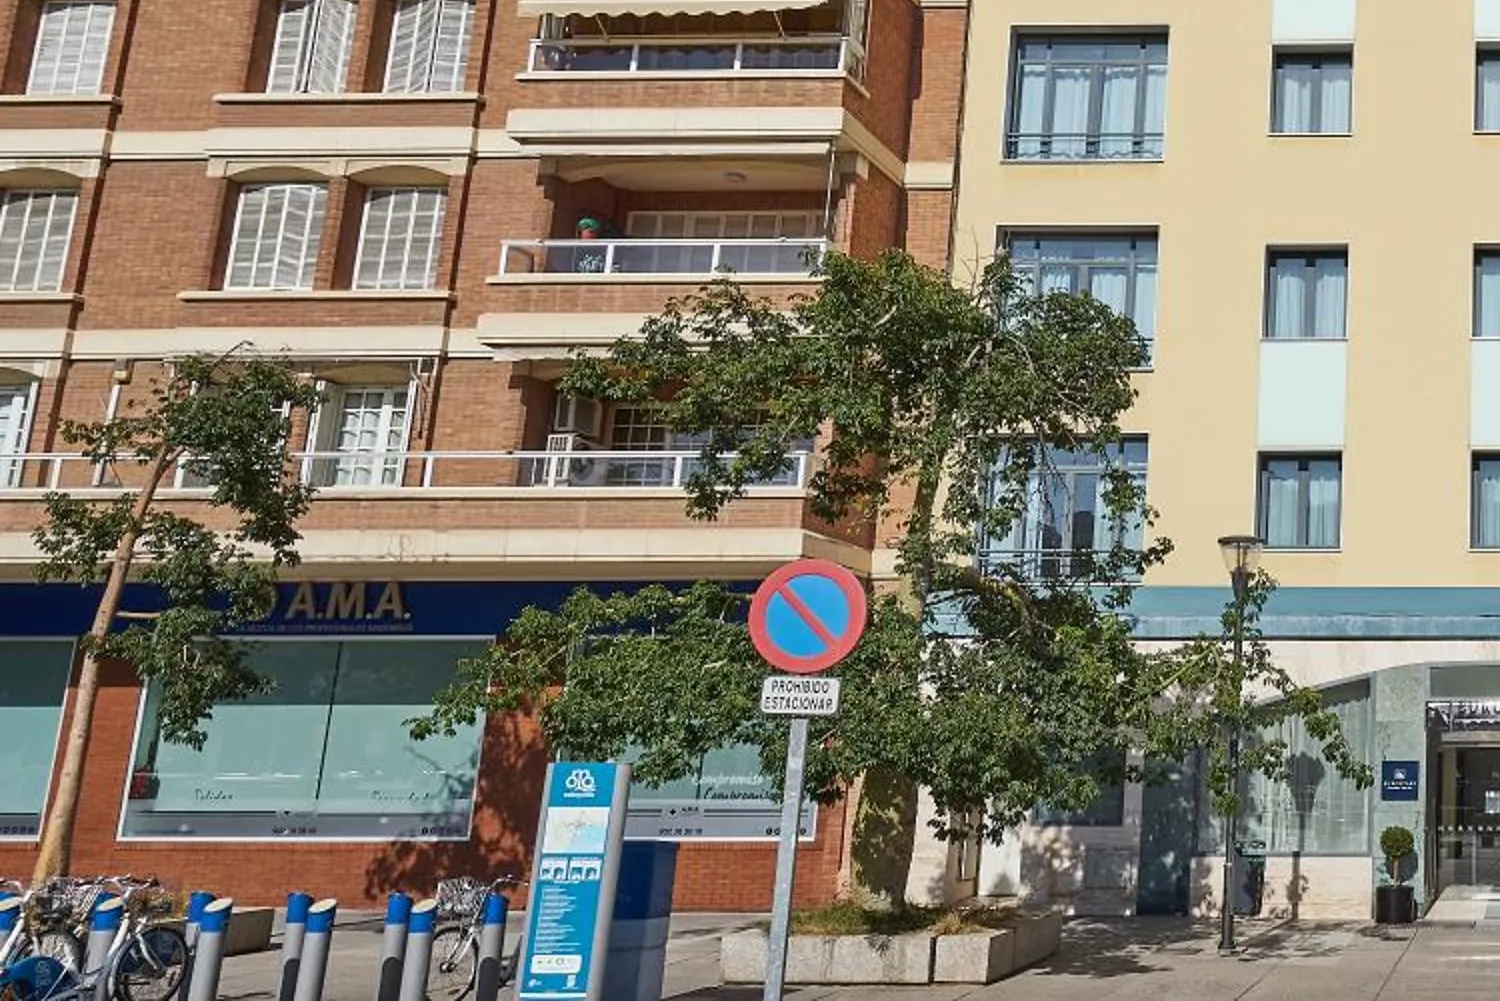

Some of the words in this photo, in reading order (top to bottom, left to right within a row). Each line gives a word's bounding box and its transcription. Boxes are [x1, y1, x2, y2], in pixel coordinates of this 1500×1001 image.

[284, 582, 411, 620] A.M.A.
[771, 680, 831, 694] PROHIBIDO
[763, 696, 834, 711] ESTACIONAR
